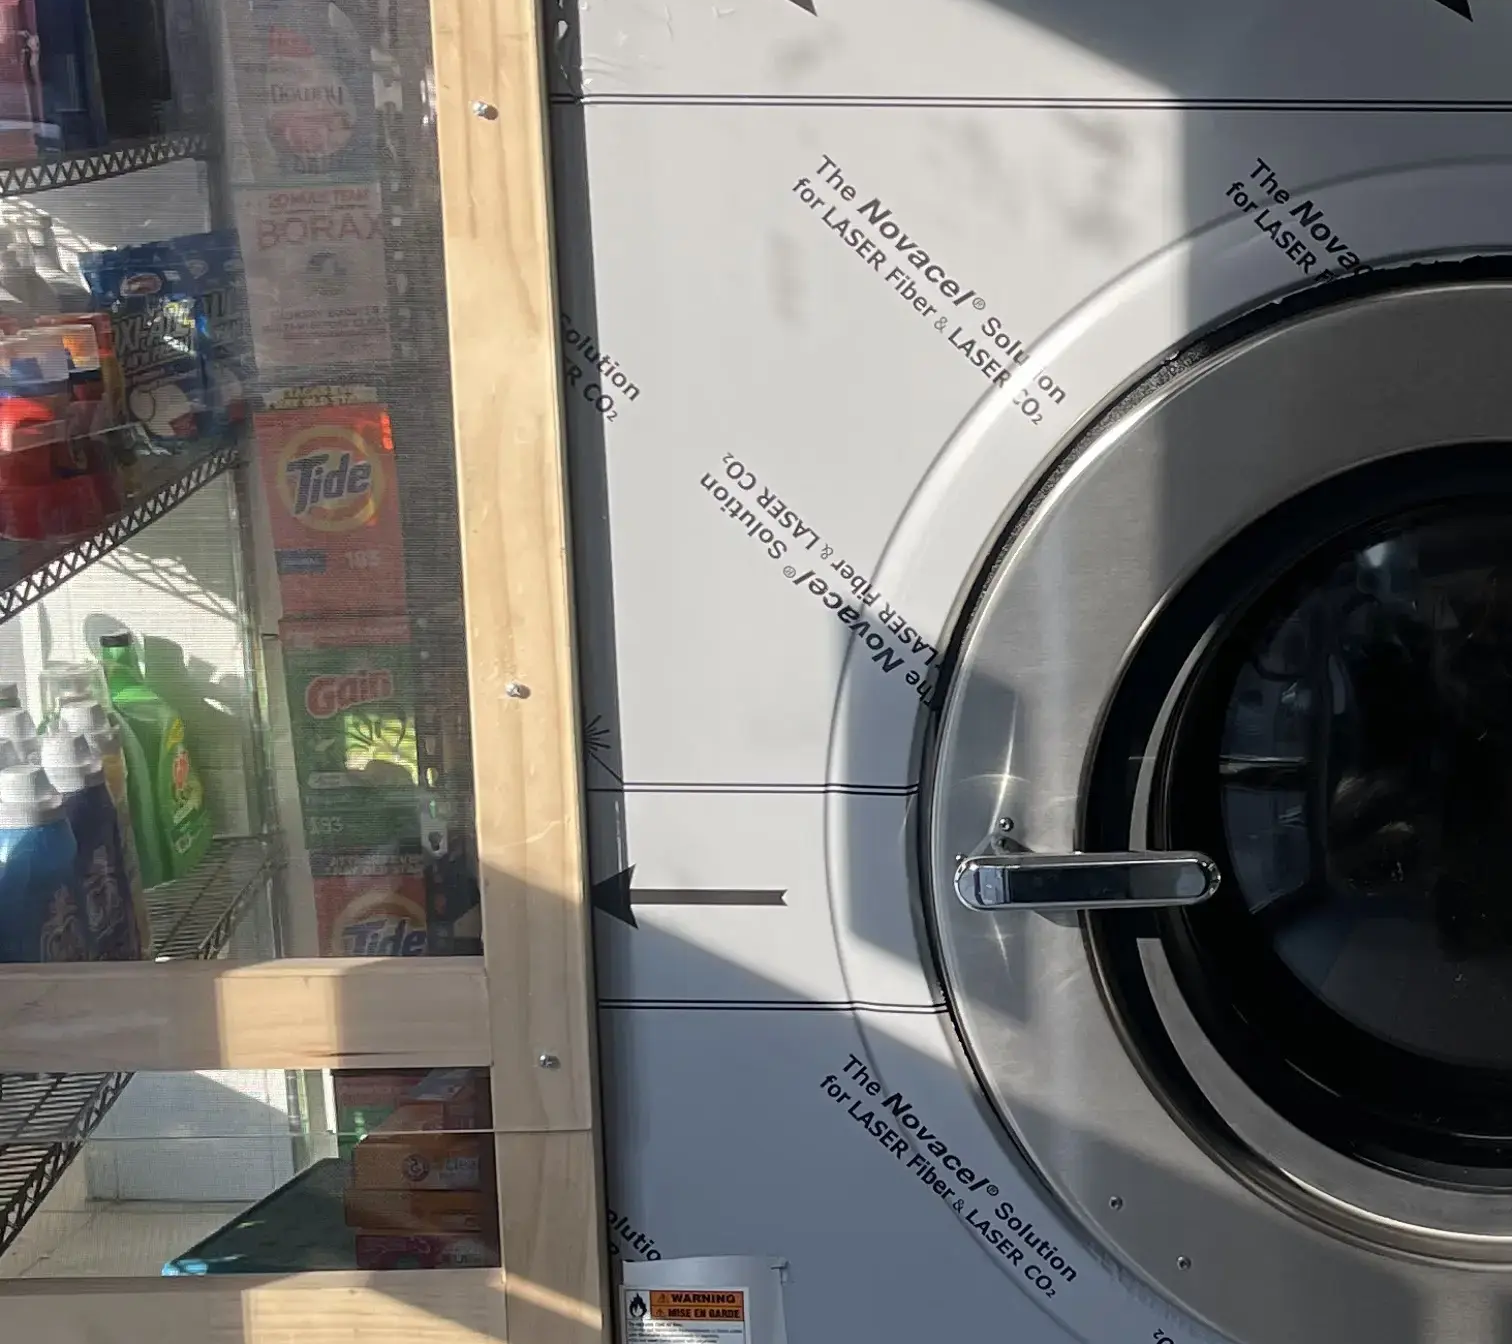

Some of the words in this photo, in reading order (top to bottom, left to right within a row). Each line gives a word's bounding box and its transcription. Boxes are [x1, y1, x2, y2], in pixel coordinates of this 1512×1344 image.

[816, 154, 857, 202] The
[256, 212, 387, 251] BORAX
[792, 177, 825, 210] for
[821, 205, 887, 272] LASER
[884, 266, 937, 317] Fiber
[933, 315, 949, 334] &
[947, 326, 1012, 388] LASER
[286, 453, 372, 515] Tide
[700, 472, 788, 560] Solution
[756, 486, 820, 550] LASER
[819, 543, 834, 560] &
[830, 559, 881, 607] Fiber
[878, 602, 939, 666] LASER
[307, 670, 392, 718] Gain
[342, 919, 427, 957] Tide
[819, 1074, 852, 1104] for
[847, 1100, 909, 1160] LASER
[905, 1152, 956, 1200] Fiber
[952, 1198, 965, 1214] &
[965, 1208, 1024, 1267] LASER
[842, 1053, 882, 1096] The
[994, 1202, 1077, 1283] Solution
[668, 1308, 693, 1319] MISE
[671, 1293, 736, 1305] WARNING
